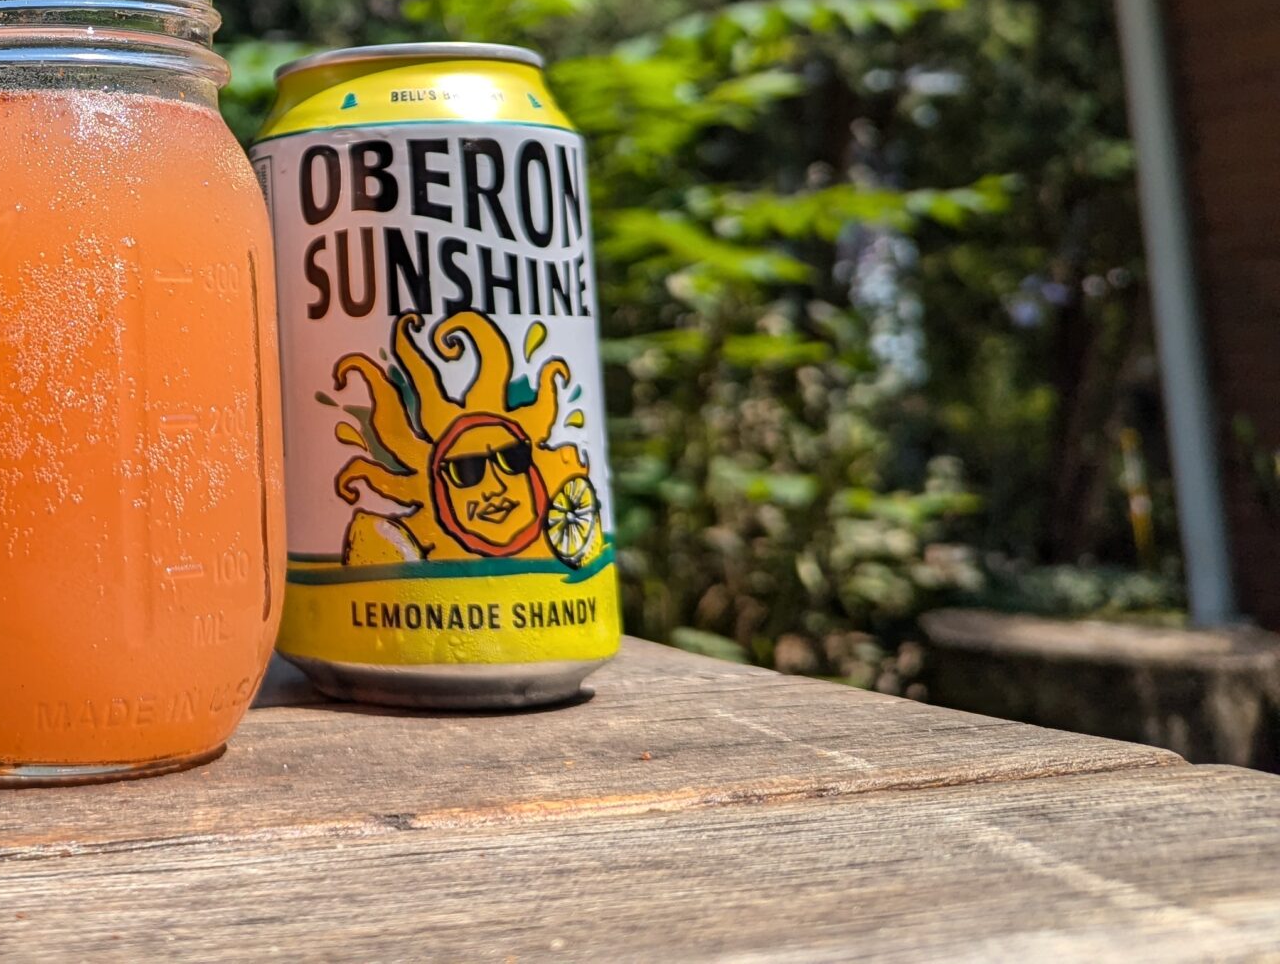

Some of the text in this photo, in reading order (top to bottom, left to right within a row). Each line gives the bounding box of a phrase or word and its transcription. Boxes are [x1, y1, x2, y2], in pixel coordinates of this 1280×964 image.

[390, 90, 437, 103] BELL'S
[298, 138, 584, 249] OBERON
[304, 226, 592, 320] SUNSHINE
[352, 596, 598, 630] LEMONADE SHANDY
[36, 694, 156, 733] MADE
